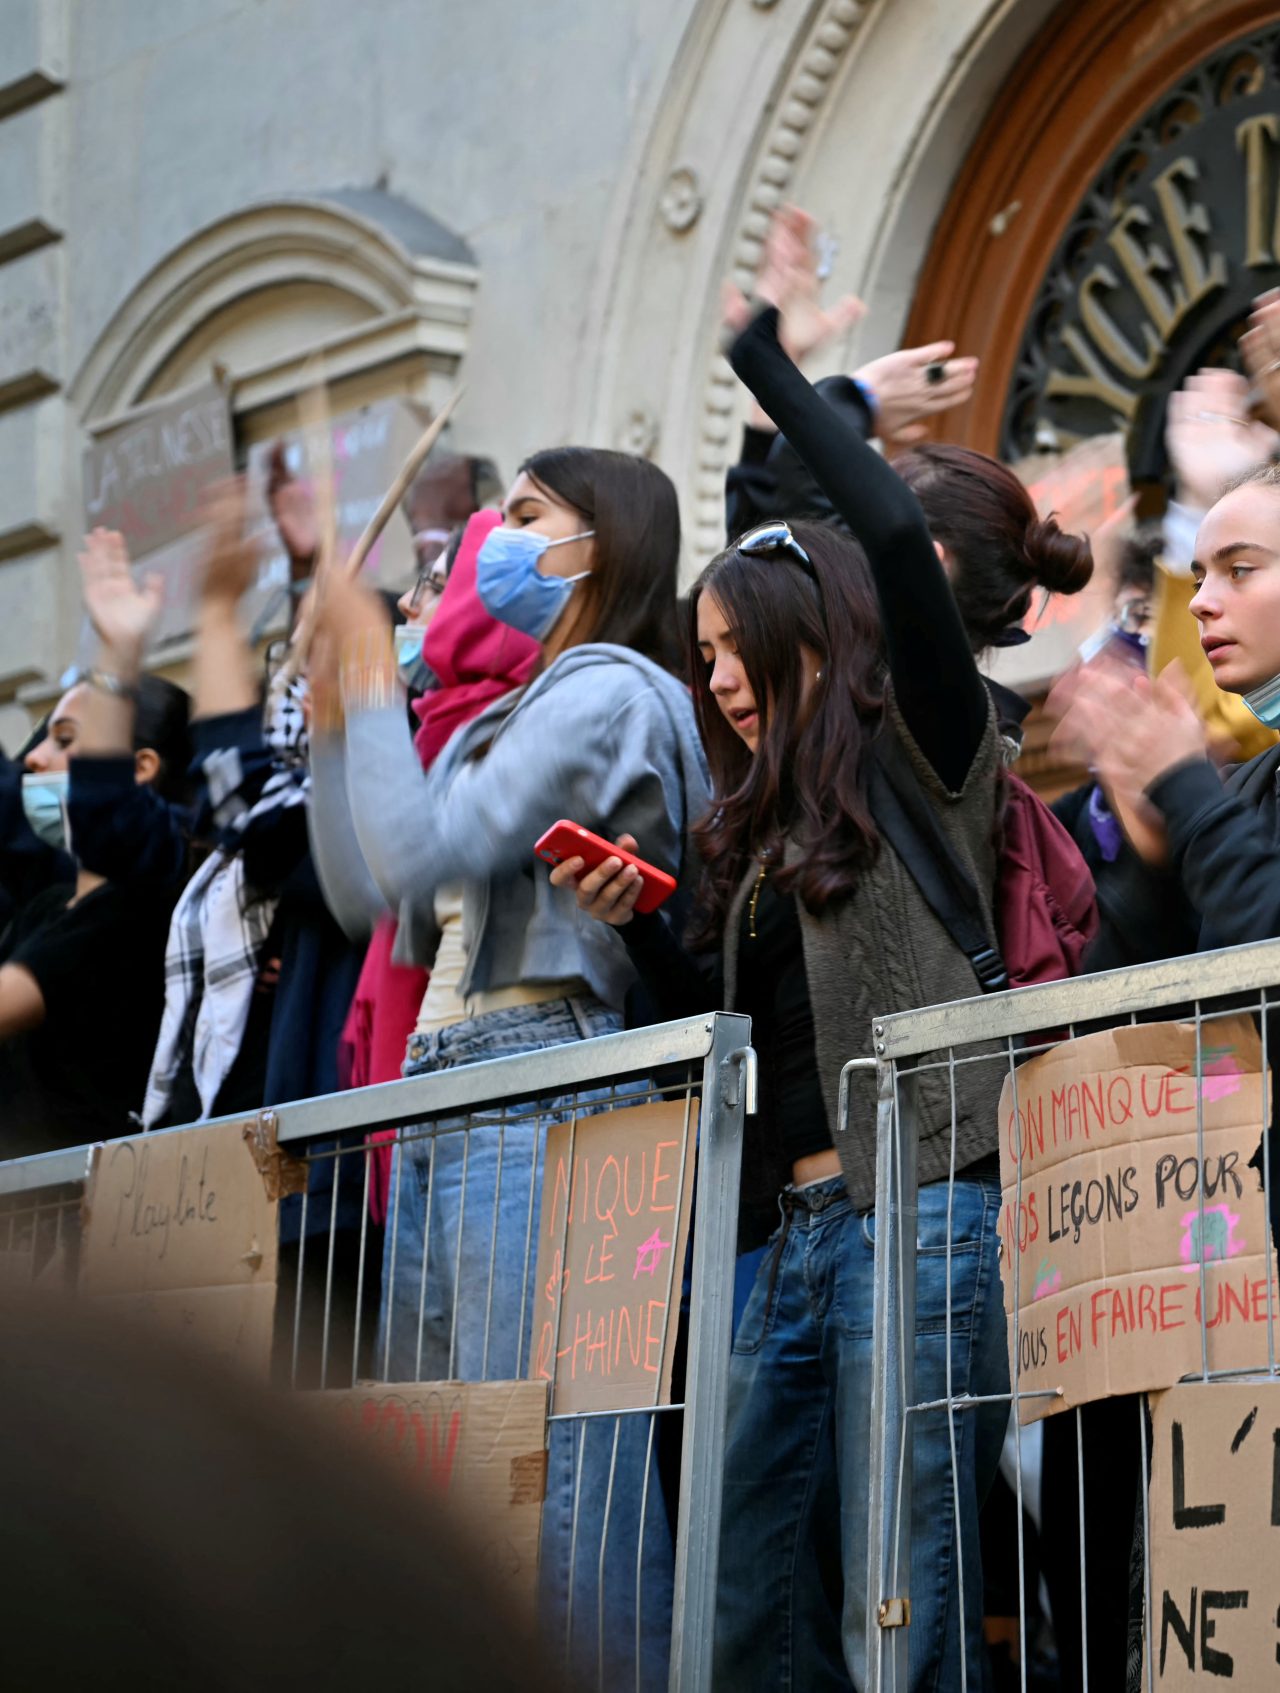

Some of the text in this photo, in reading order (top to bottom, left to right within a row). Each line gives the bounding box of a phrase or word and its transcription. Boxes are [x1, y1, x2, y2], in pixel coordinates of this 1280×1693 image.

[1008, 1065, 1195, 1166] ON MANQUE
[549, 1141, 679, 1237] NIQUE
[1006, 1150, 1243, 1270] NOS LEÇONS POUR
[584, 1234, 615, 1284] LE
[1056, 1301, 1082, 1364] EN
[1090, 1283, 1186, 1349] FAIRE
[1195, 1272, 1278, 1329] UNE
[1158, 1586, 1249, 1678] NE
